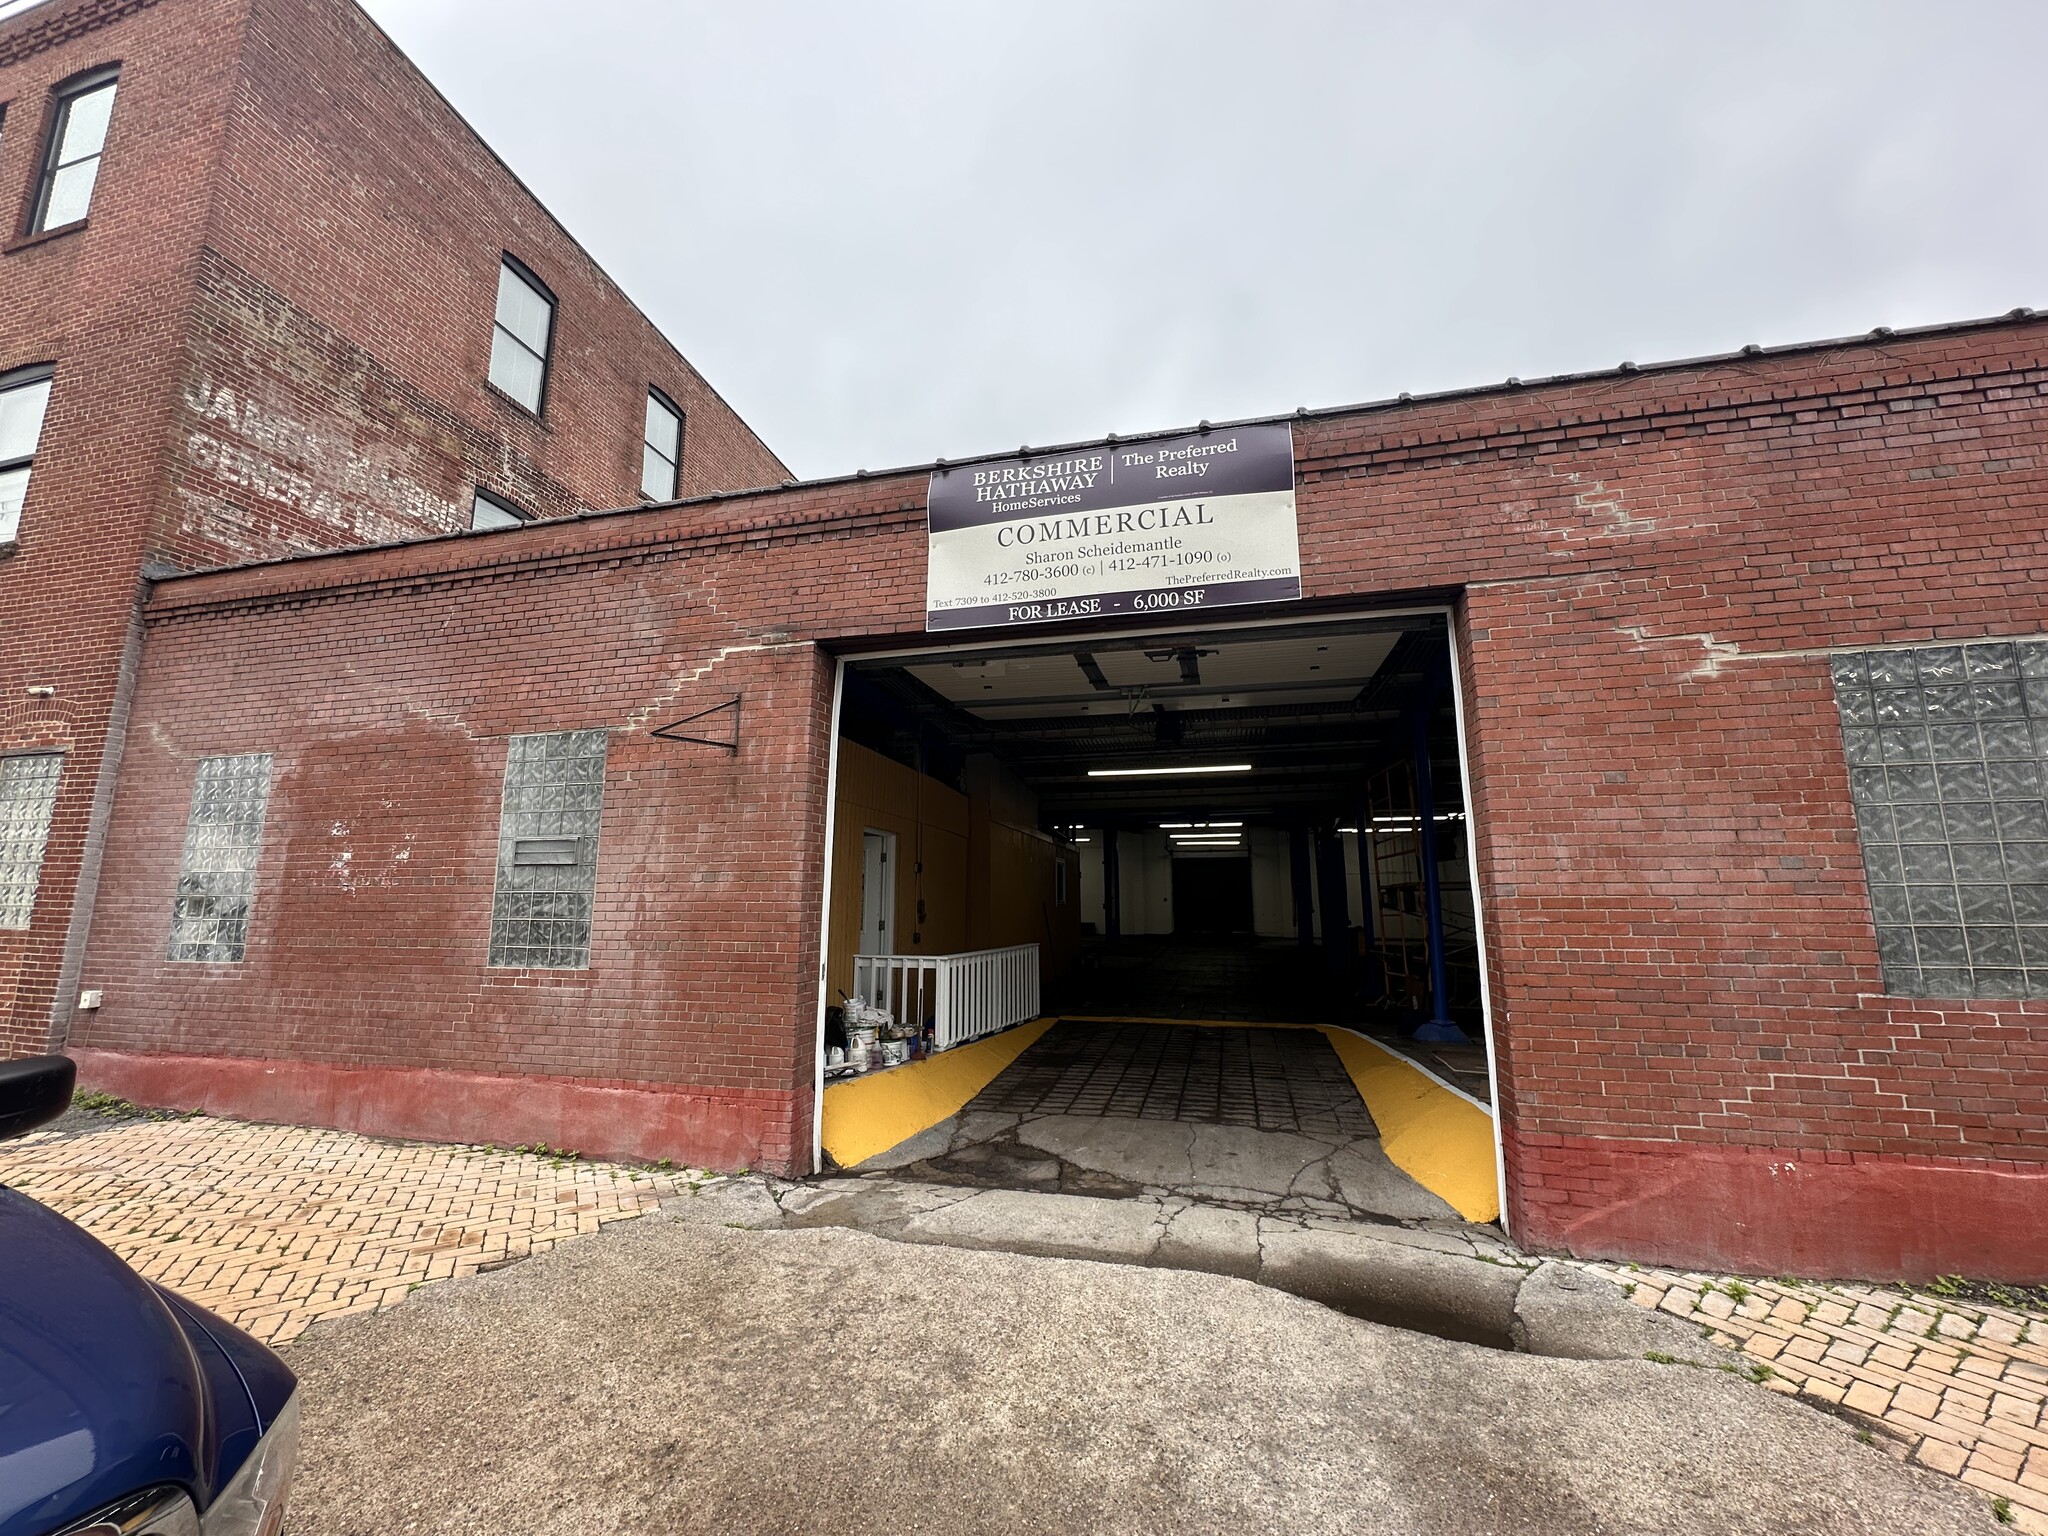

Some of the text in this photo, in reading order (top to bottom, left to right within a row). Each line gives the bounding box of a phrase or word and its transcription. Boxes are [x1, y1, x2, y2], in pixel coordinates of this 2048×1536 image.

[1121, 438, 1238, 467] The Preferred
[973, 456, 1103, 486] BERKSHIRE
[1155, 461, 1210, 478] Realty
[976, 472, 1098, 502] HATHAWAY
[991, 494, 1081, 514] HomeServices
[997, 503, 1214, 548] COMMERCIAL
[1025, 536, 1182, 565] Sharon Scheidemantle
[983, 564, 1079, 586] 412-780-3600
[1108, 550, 1213, 572] 412-471-1090
[1165, 566, 1292, 586] ThePreferredRealty.com
[933, 587, 1057, 608] Text 7309 to 412-520-3800
[1008, 605, 1043, 621] FOR
[1046, 598, 1101, 618] LEASE
[1133, 592, 1179, 611] 6,000
[1183, 589, 1205, 605] SF
